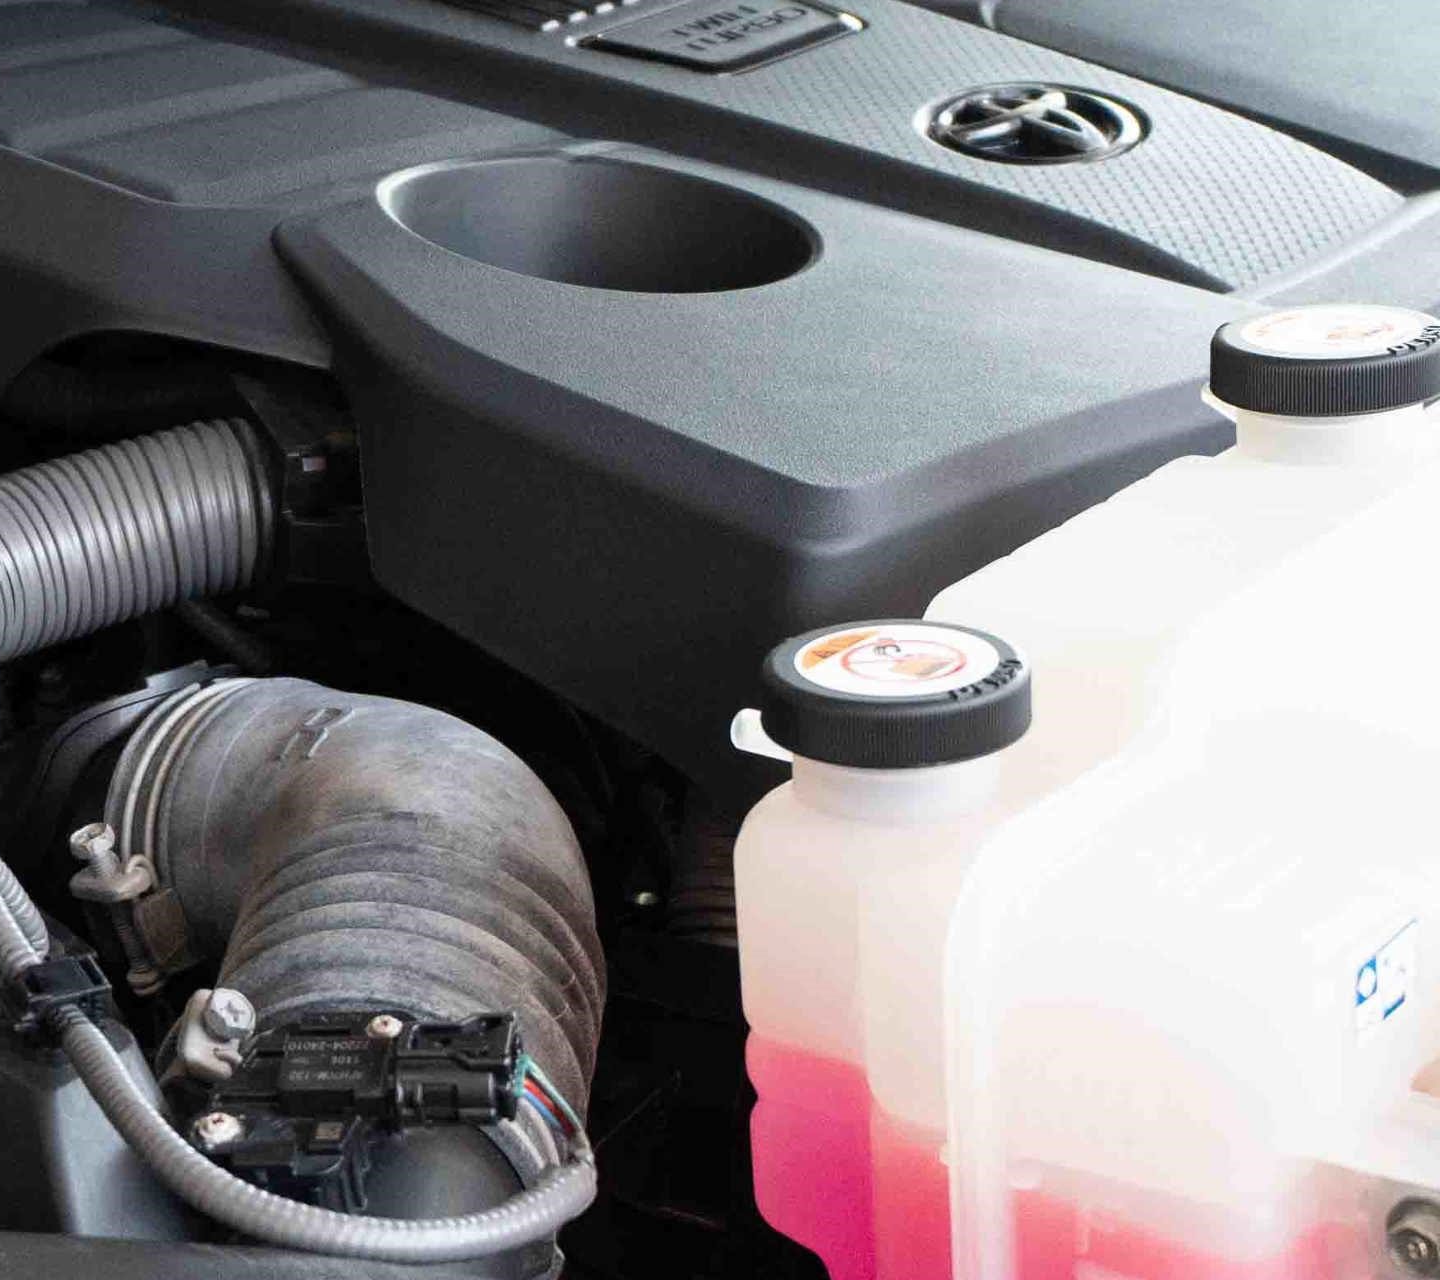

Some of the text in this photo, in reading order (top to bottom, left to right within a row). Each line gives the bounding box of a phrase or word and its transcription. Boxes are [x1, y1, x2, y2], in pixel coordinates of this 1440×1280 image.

[671, 4, 759, 37] TWIN
[685, 6, 808, 52] TURBO
[277, 706, 356, 764] R
